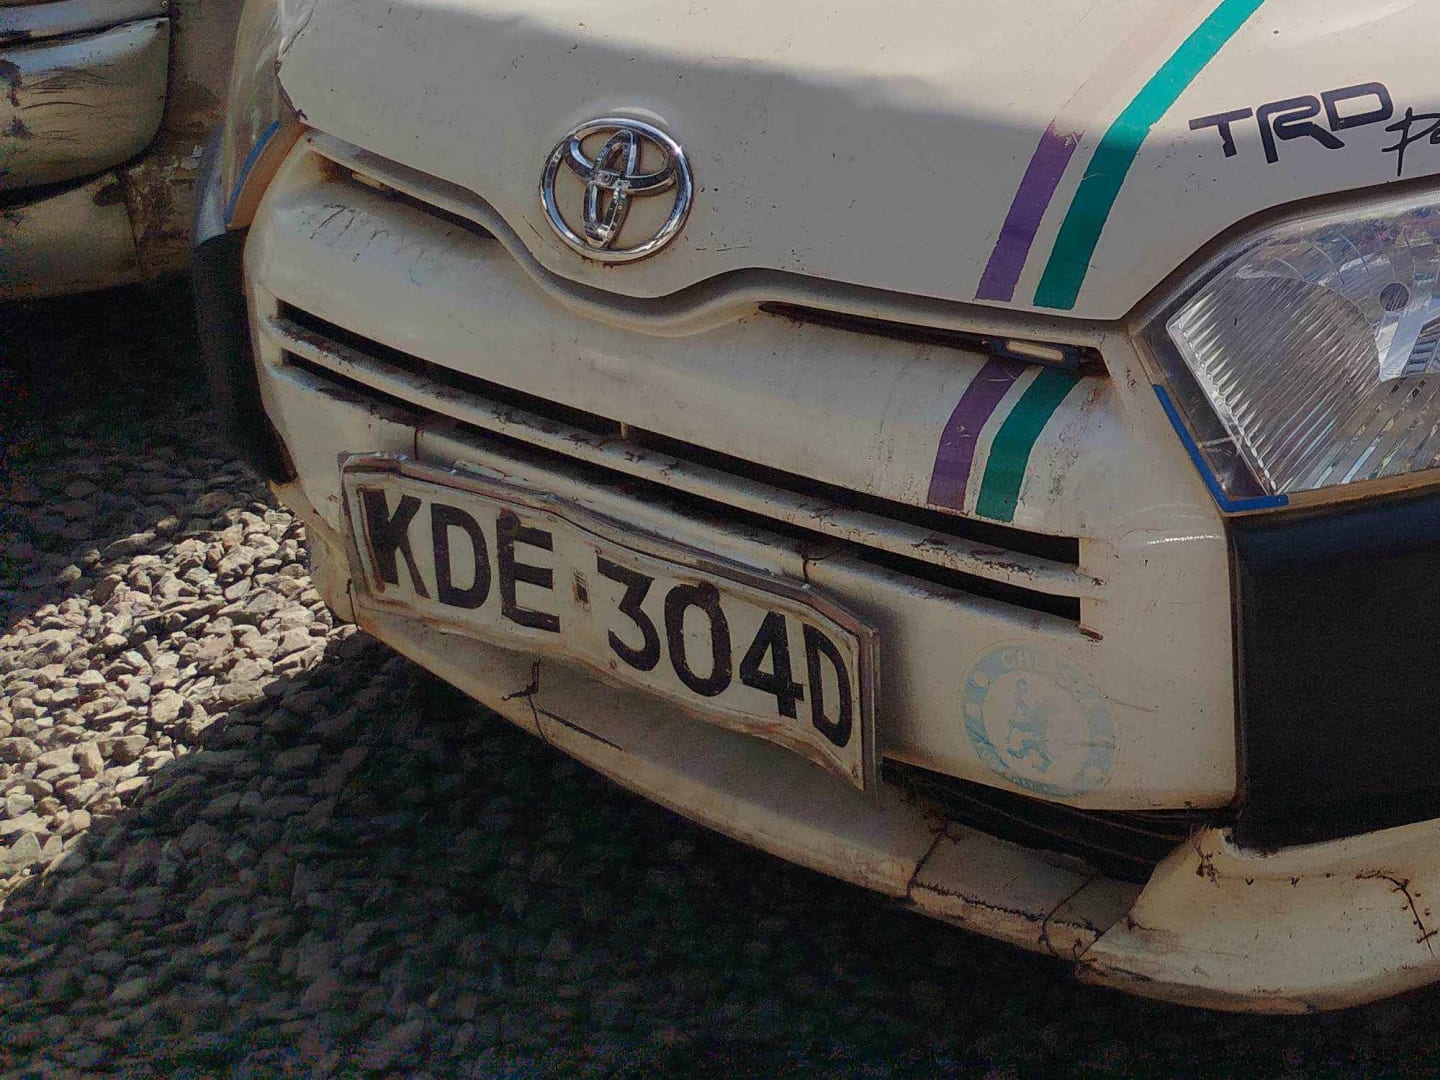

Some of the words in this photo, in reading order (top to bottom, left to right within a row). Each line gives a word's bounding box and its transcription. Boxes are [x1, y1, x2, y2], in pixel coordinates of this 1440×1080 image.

[1188, 81, 1394, 164] TRD
[361, 487, 561, 634] KDE
[595, 555, 855, 749] 304D
